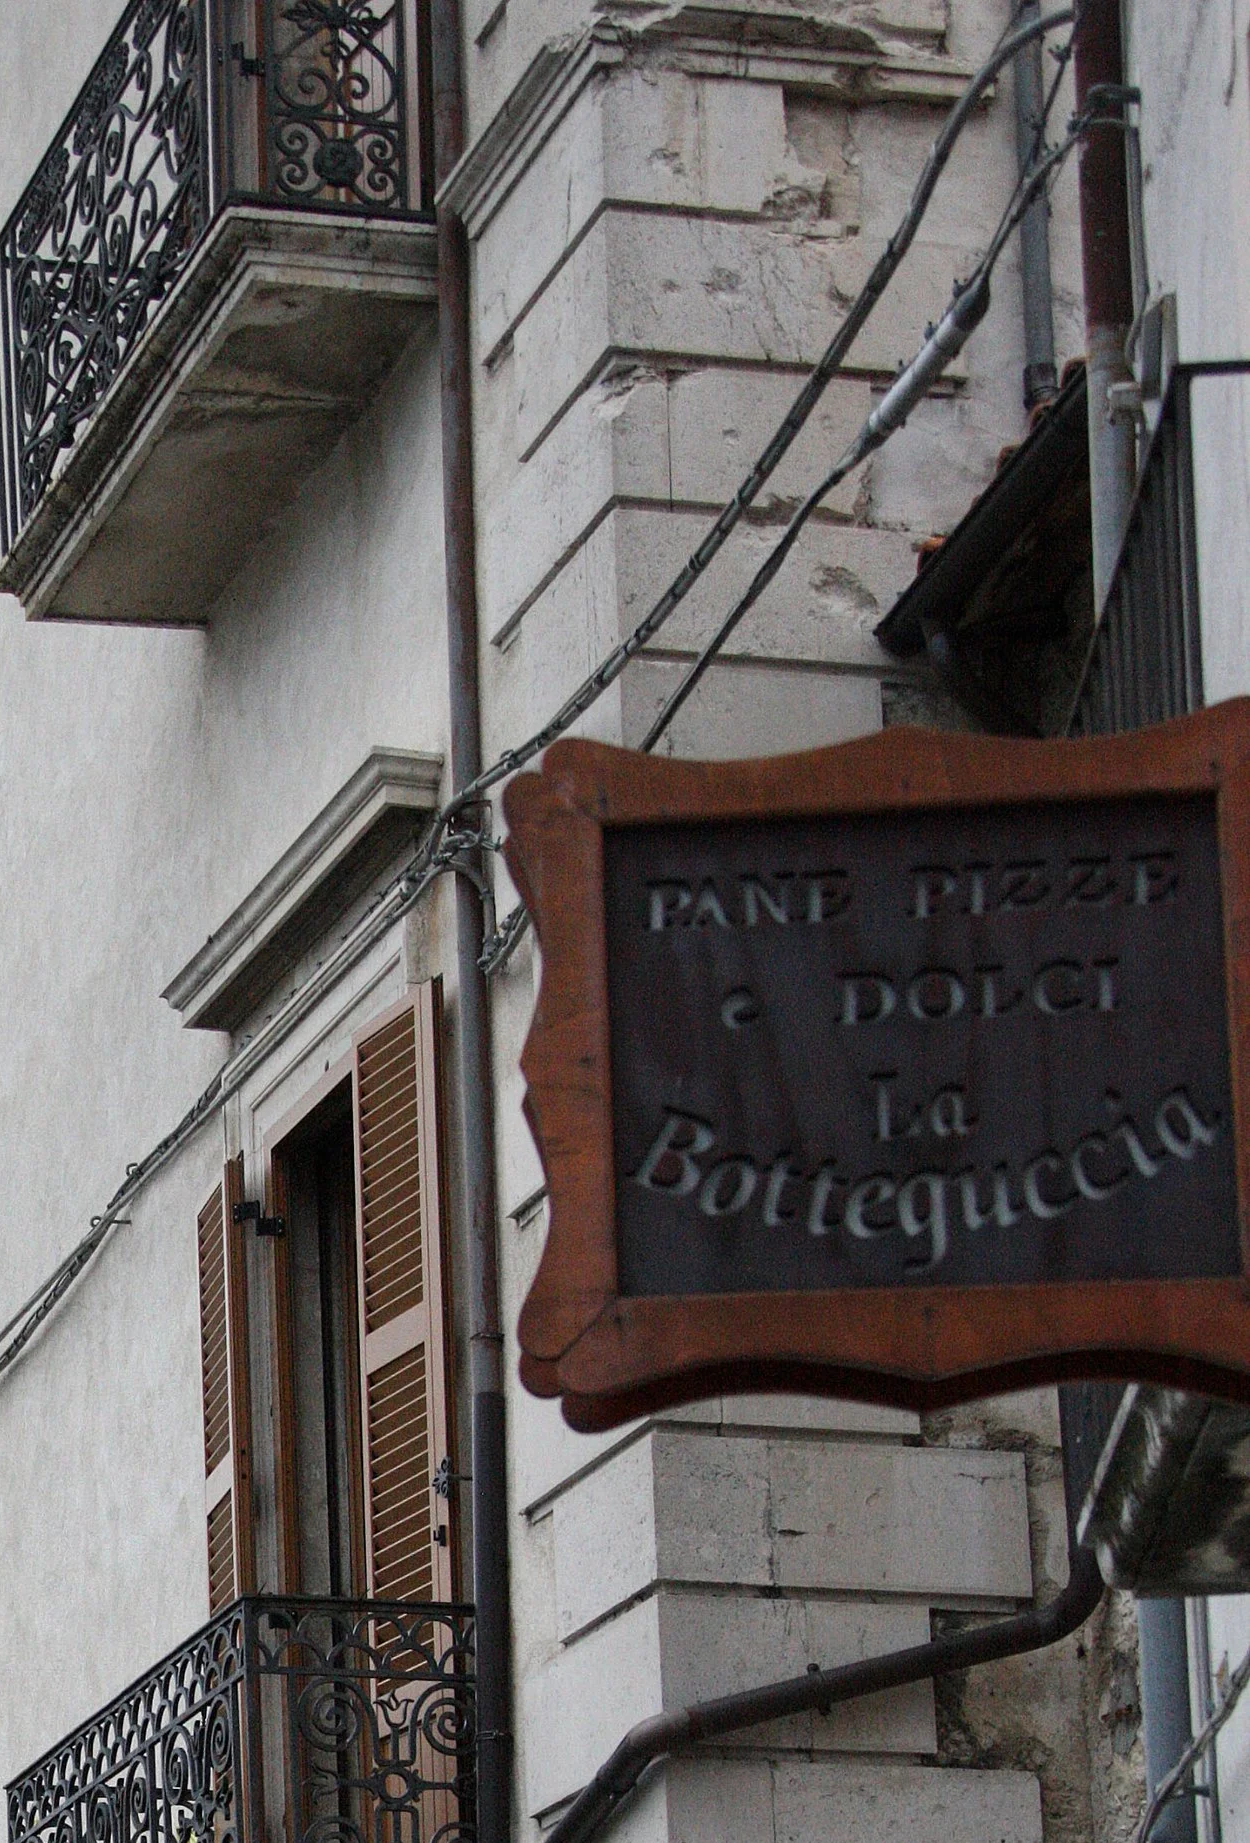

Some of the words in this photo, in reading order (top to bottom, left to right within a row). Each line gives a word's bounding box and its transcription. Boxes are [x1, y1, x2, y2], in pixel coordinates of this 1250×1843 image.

[644, 868, 849, 932] PANE
[907, 850, 1179, 920] PIZZE
[835, 956, 1121, 1026] DOLCI
[867, 1070, 977, 1141] La
[627, 1083, 1224, 1274] Botteguccia
